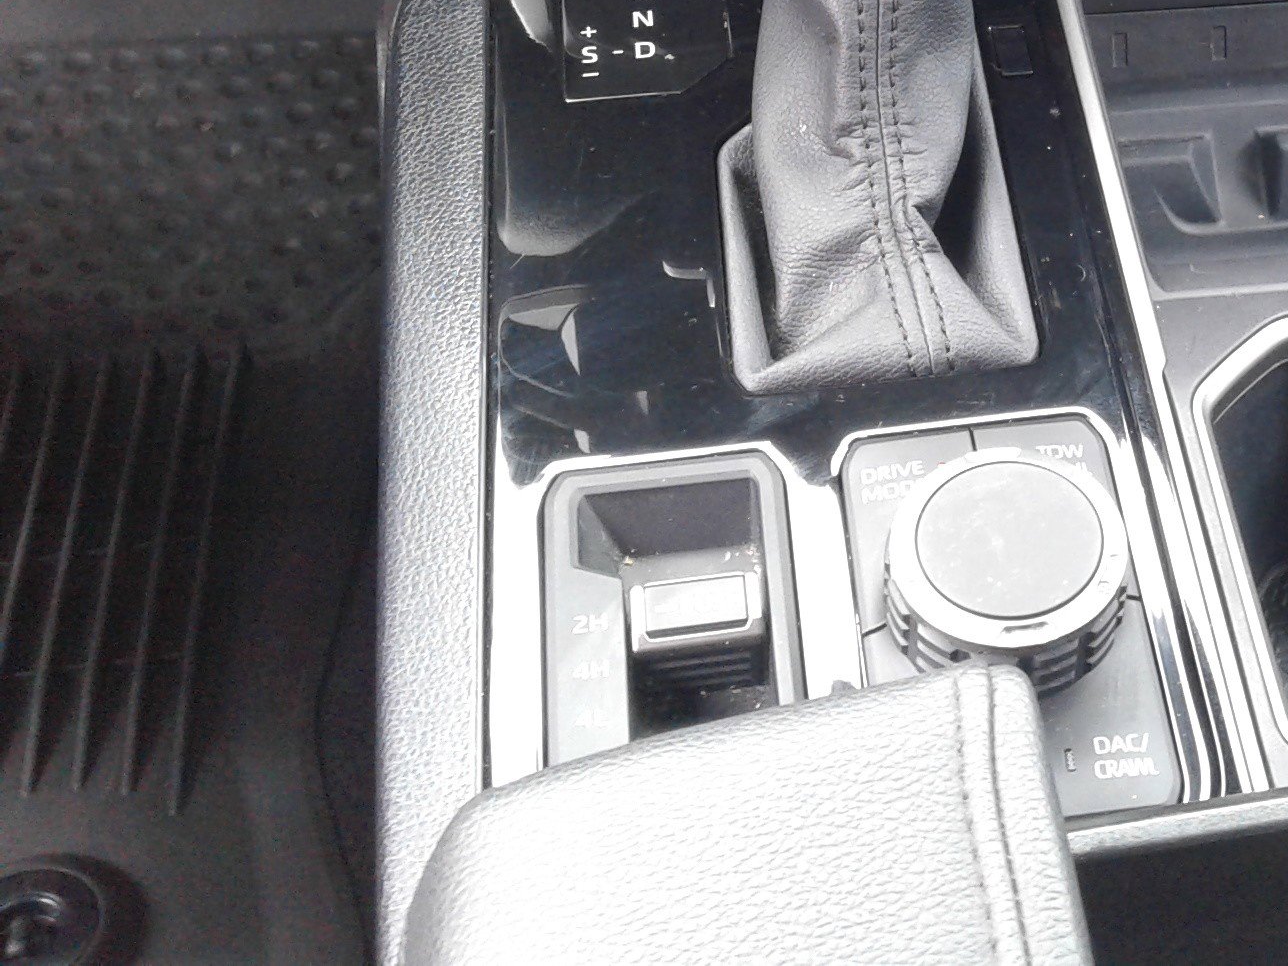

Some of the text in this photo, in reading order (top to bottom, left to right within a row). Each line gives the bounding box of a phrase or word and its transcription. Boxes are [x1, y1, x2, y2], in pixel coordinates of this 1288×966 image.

[632, 10, 654, 28] N
[634, 41, 656, 60] D
[1035, 443, 1084, 459] TOW
[860, 460, 925, 485] DRIVE
[861, 480, 917, 505] MOD
[571, 614, 609, 635] 2H
[1093, 732, 1150, 755] DAC/
[1094, 757, 1160, 780] CRAWL
